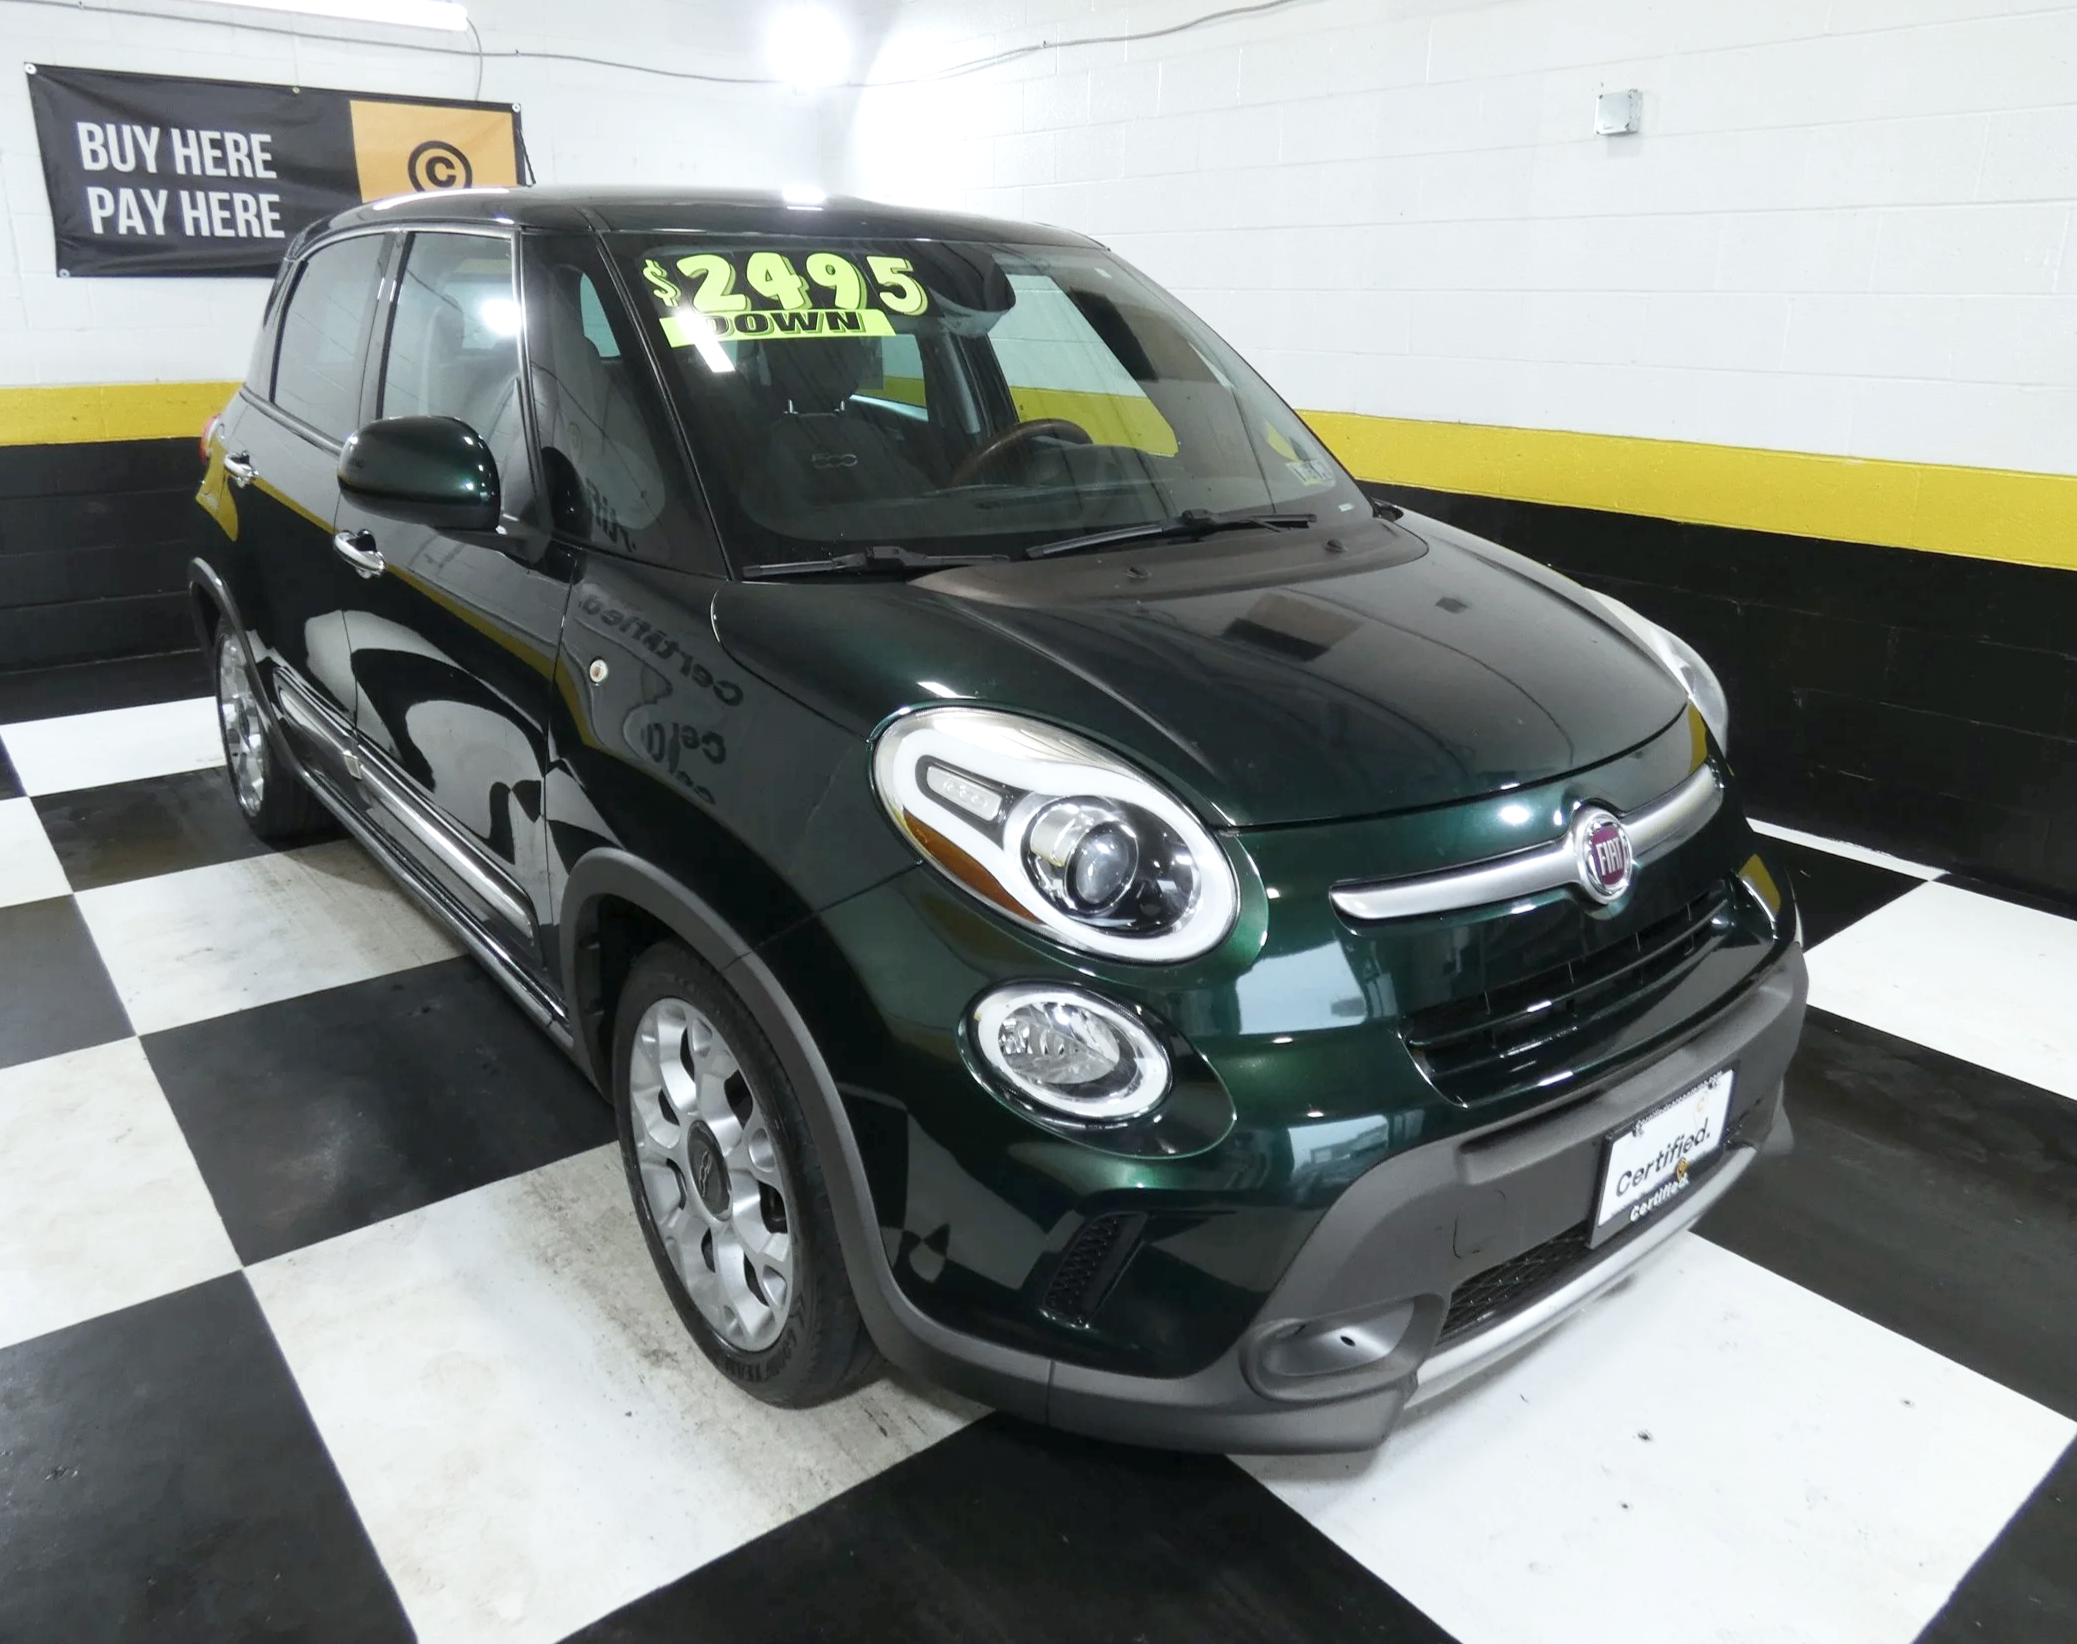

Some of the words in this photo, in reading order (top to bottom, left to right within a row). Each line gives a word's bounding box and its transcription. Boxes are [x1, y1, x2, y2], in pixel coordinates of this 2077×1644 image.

[77, 121, 160, 172] BUY
[171, 127, 277, 179] HERE
[86, 186, 168, 235] PAY
[181, 191, 285, 239] HERE
[642, 251, 928, 317] $2495
[1596, 837, 1623, 876] FIAT
